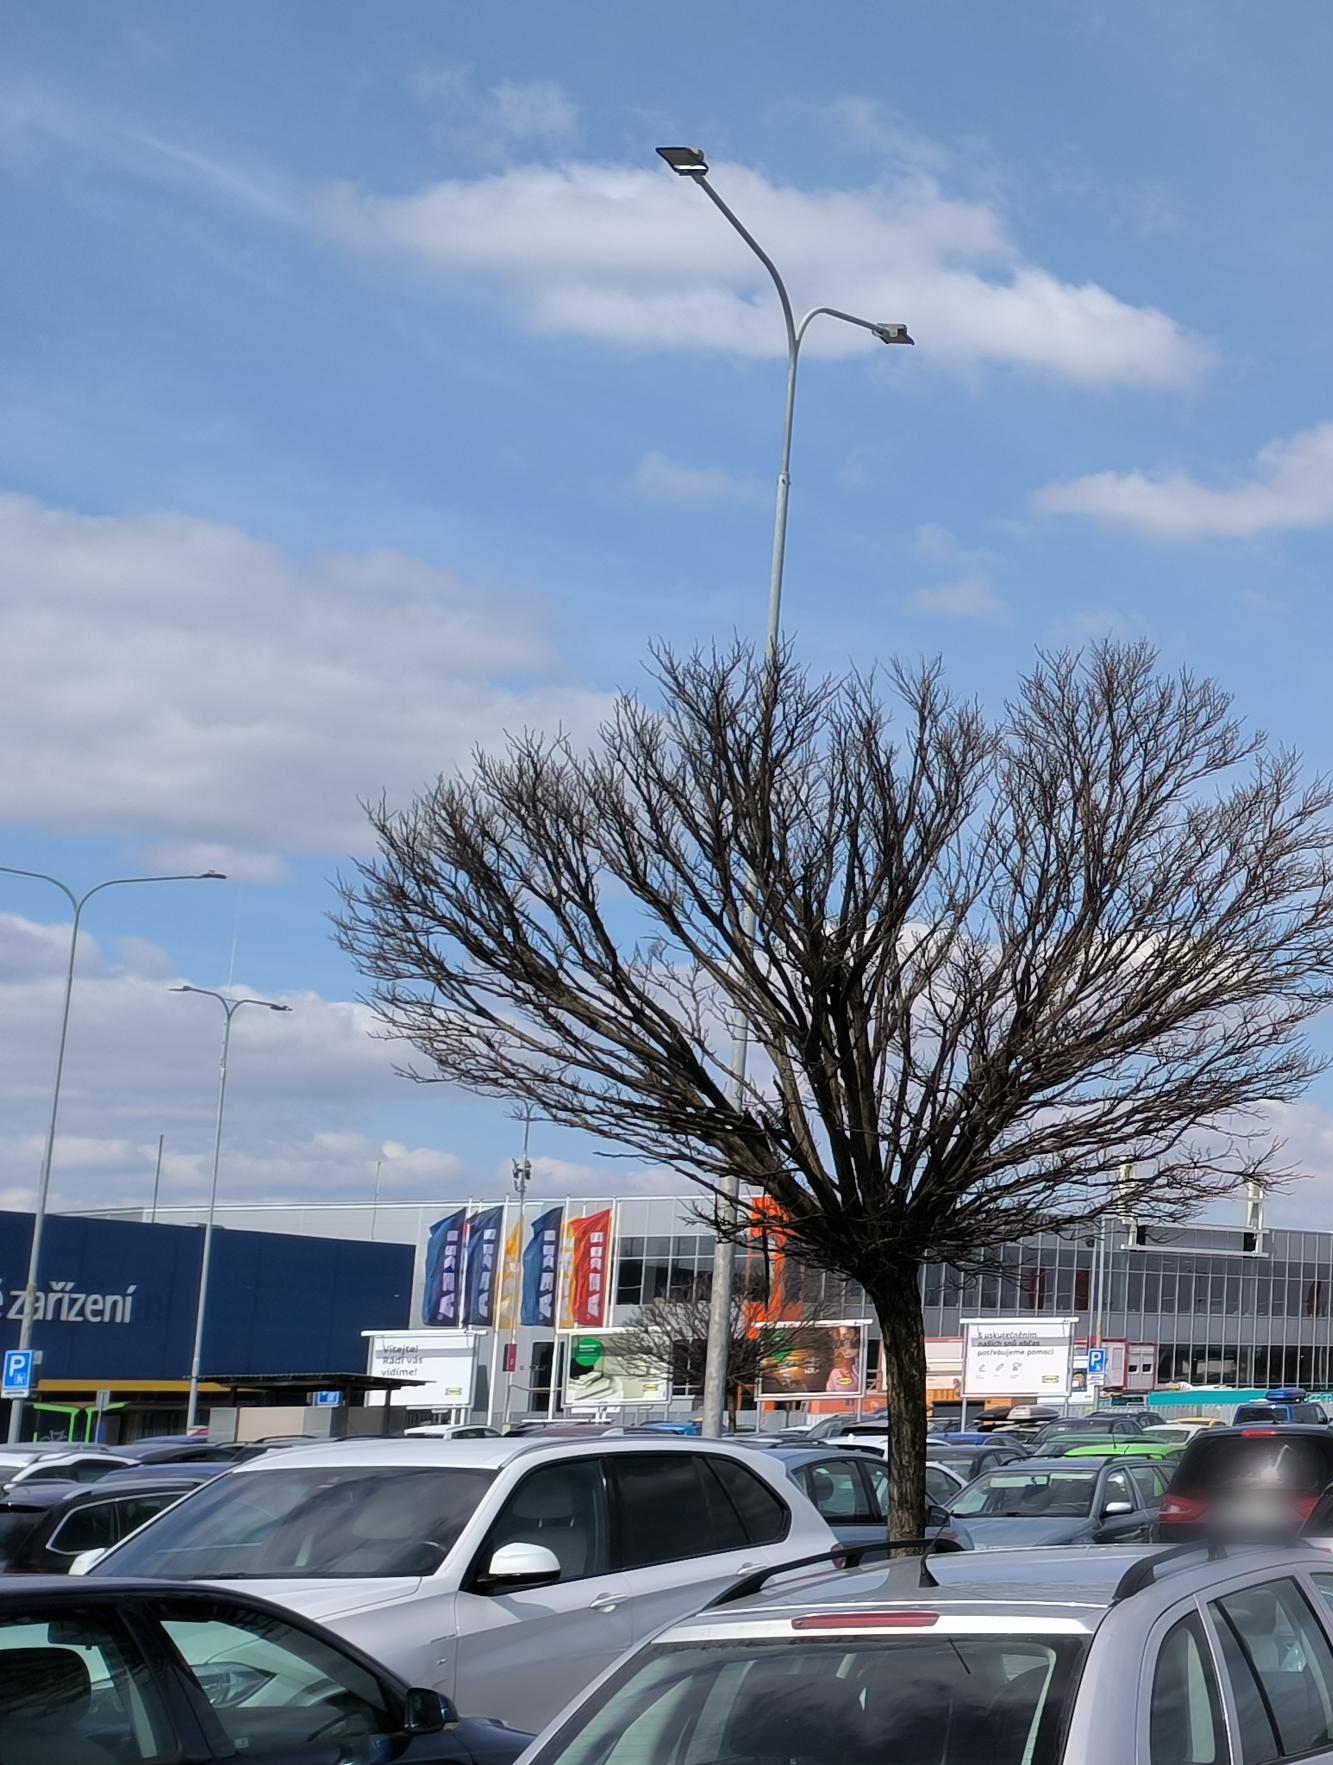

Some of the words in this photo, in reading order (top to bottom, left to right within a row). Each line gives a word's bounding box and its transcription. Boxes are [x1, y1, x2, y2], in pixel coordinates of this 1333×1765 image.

[7, 1281, 137, 1323] zařízení
[9, 1355, 25, 1377] P
[1091, 1352, 1101, 1366] P
